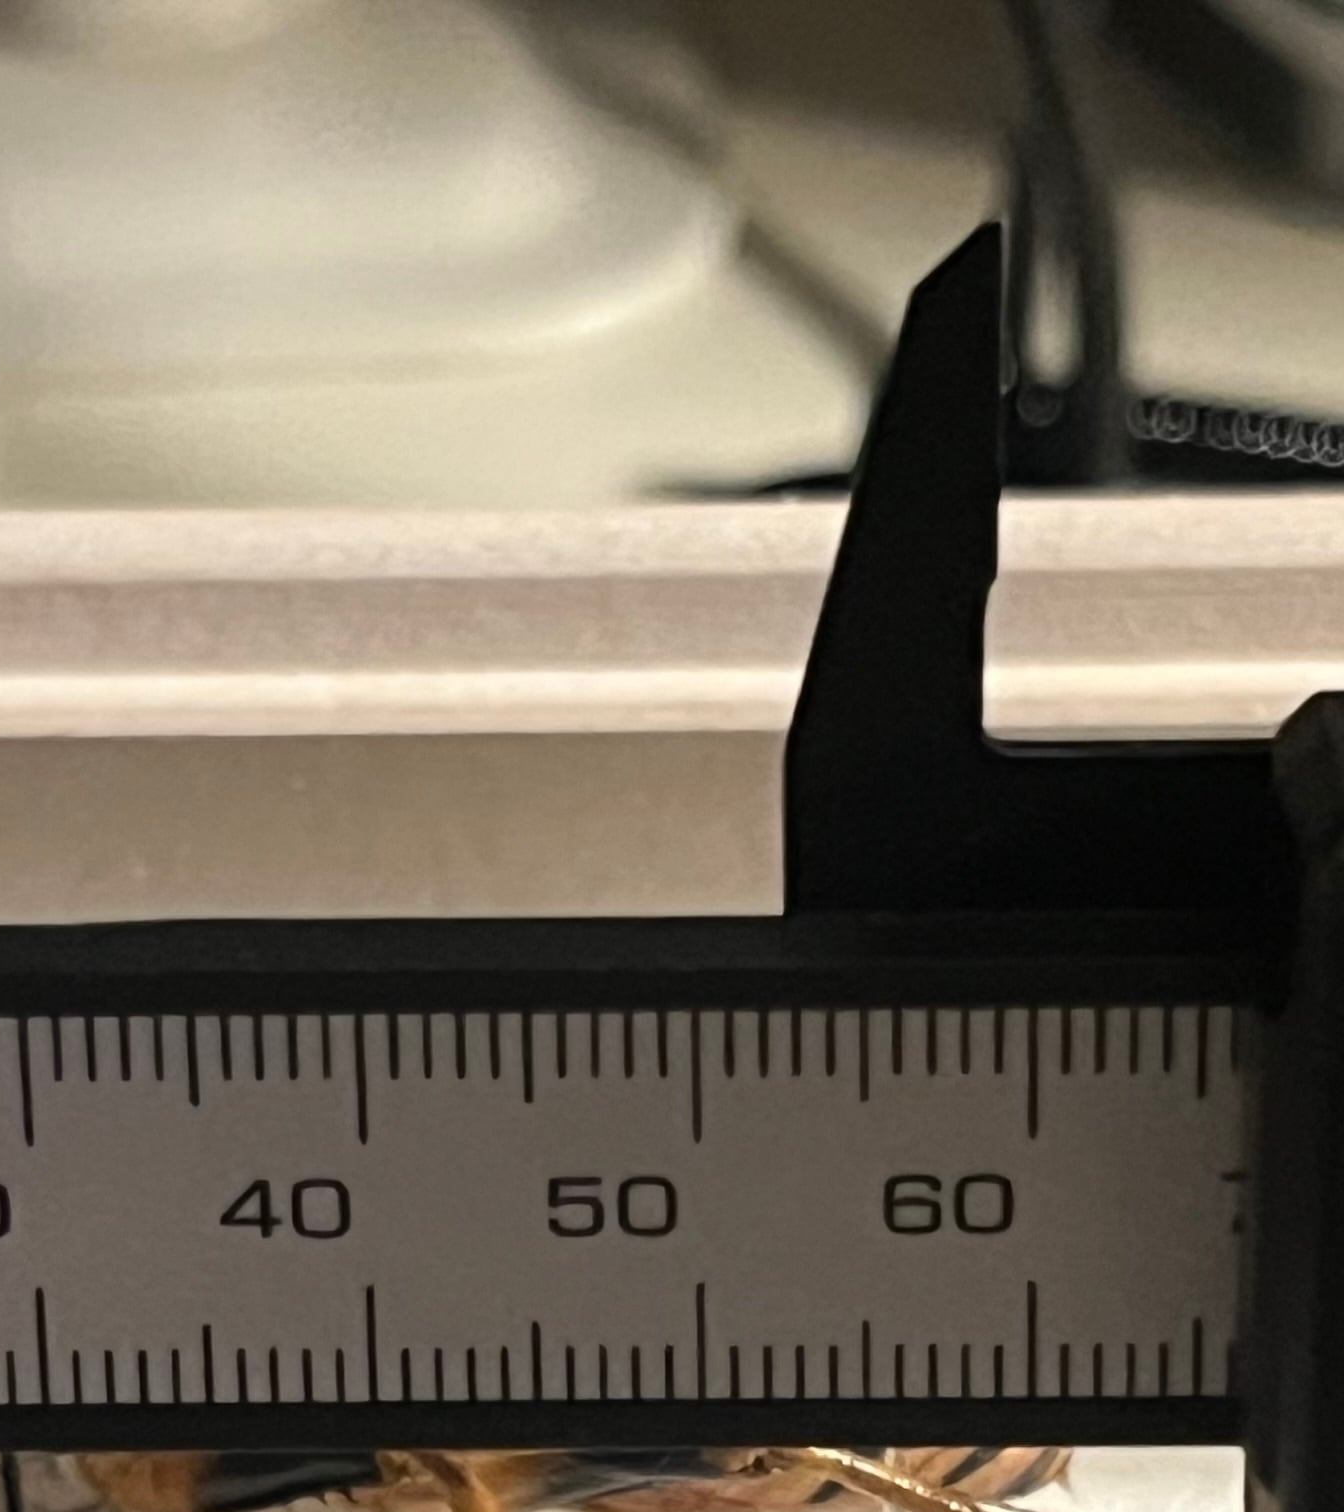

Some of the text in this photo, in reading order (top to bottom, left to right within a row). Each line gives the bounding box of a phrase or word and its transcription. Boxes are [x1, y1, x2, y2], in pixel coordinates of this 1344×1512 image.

[218, 1176, 353, 1241] 40
[546, 1174, 679, 1239] 50
[881, 1171, 1016, 1237] 60
